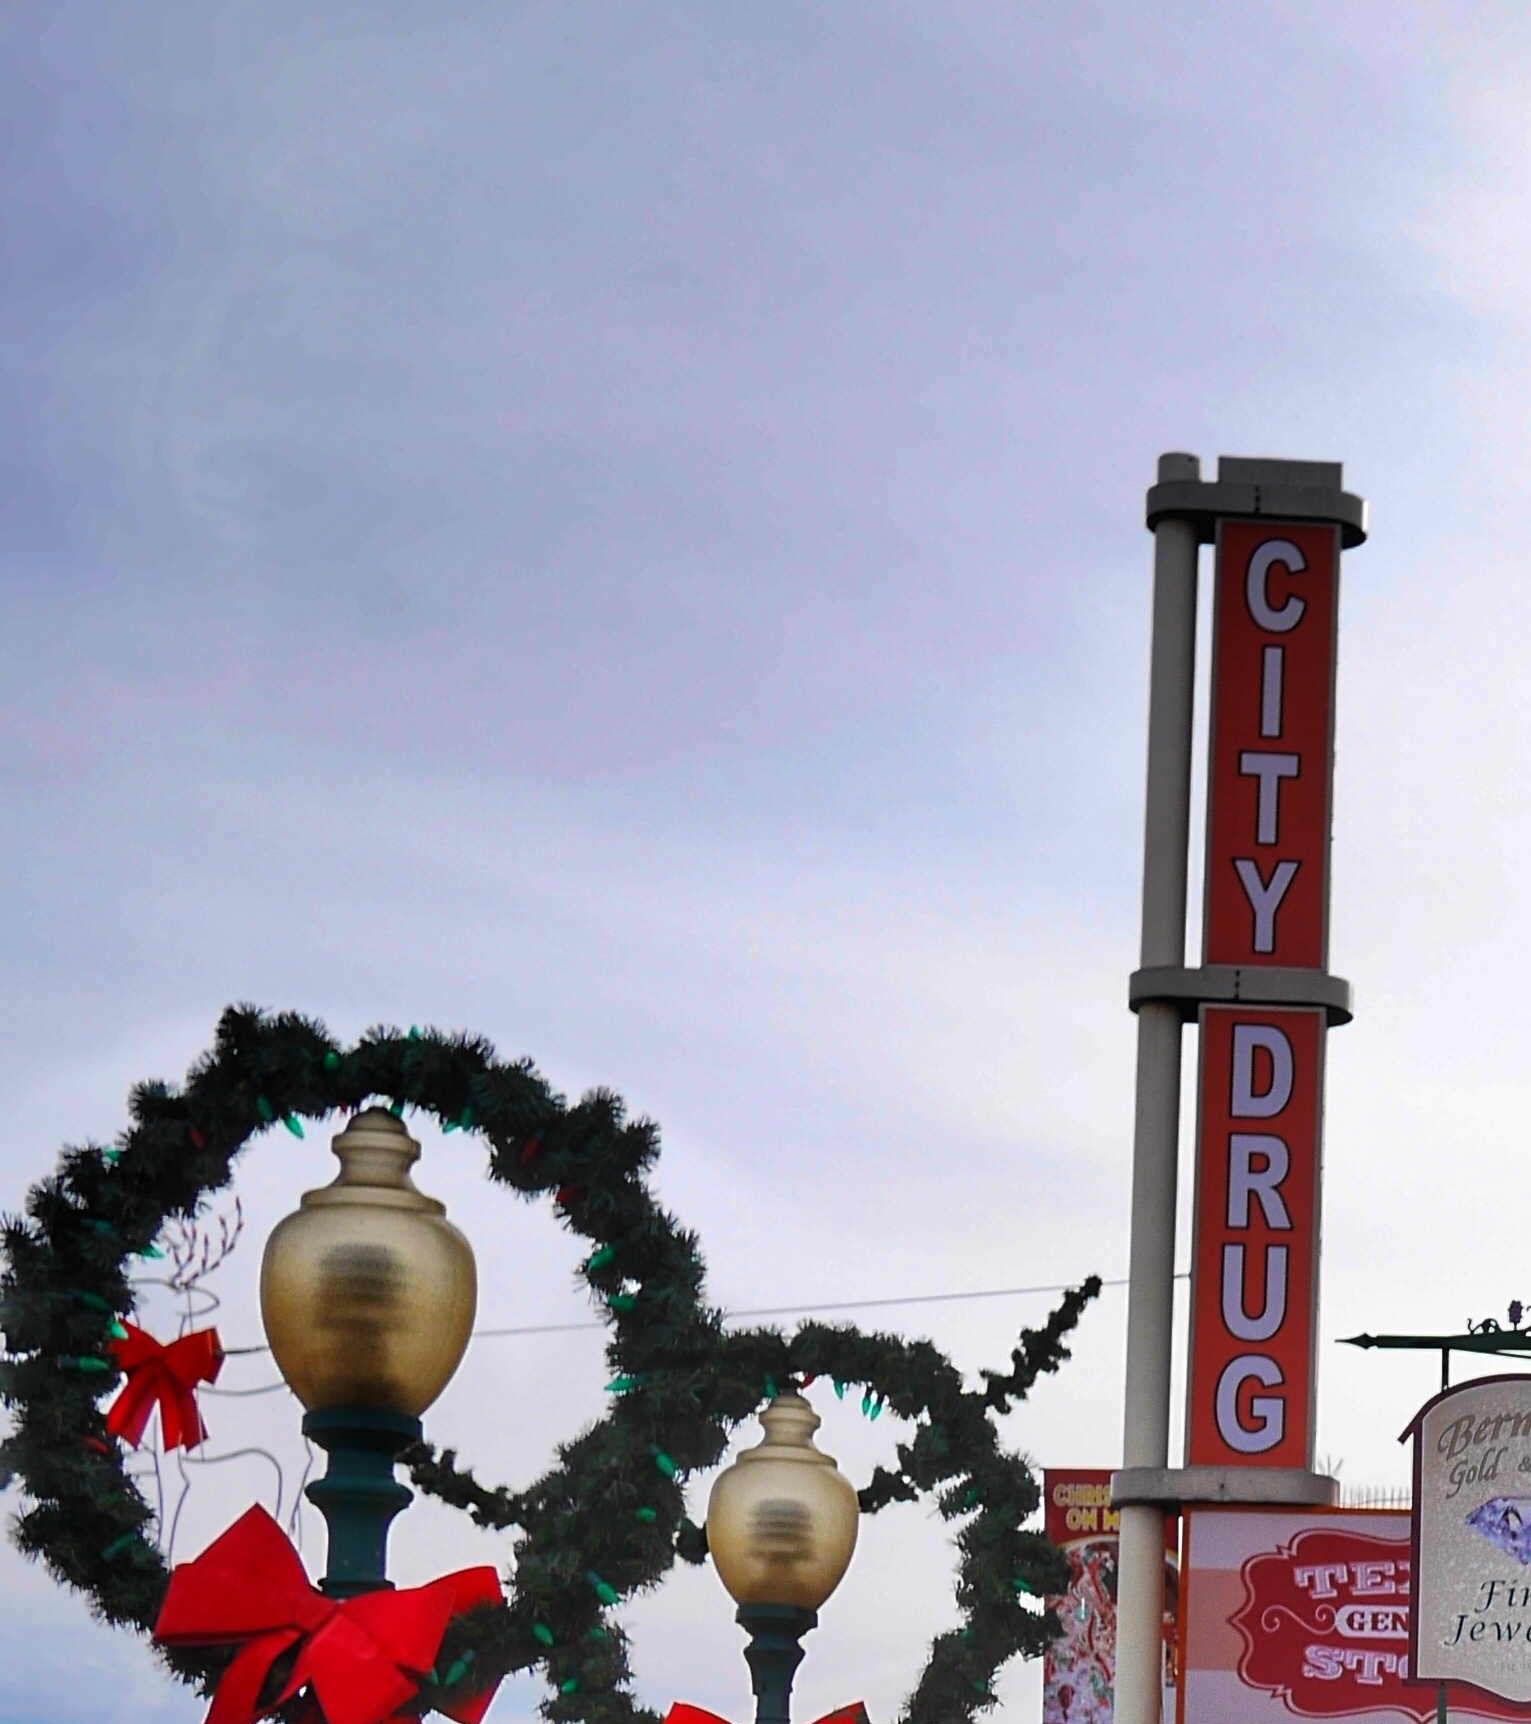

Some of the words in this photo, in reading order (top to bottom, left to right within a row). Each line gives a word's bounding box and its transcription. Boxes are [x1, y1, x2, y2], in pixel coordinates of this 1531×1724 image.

[1232, 538, 1307, 954] CITY
[1214, 1023, 1296, 1454] DRUG
[1446, 1447, 1509, 1499] Gold
[1066, 1507, 1098, 1531] ON
[1302, 1644, 1408, 1685] ST
